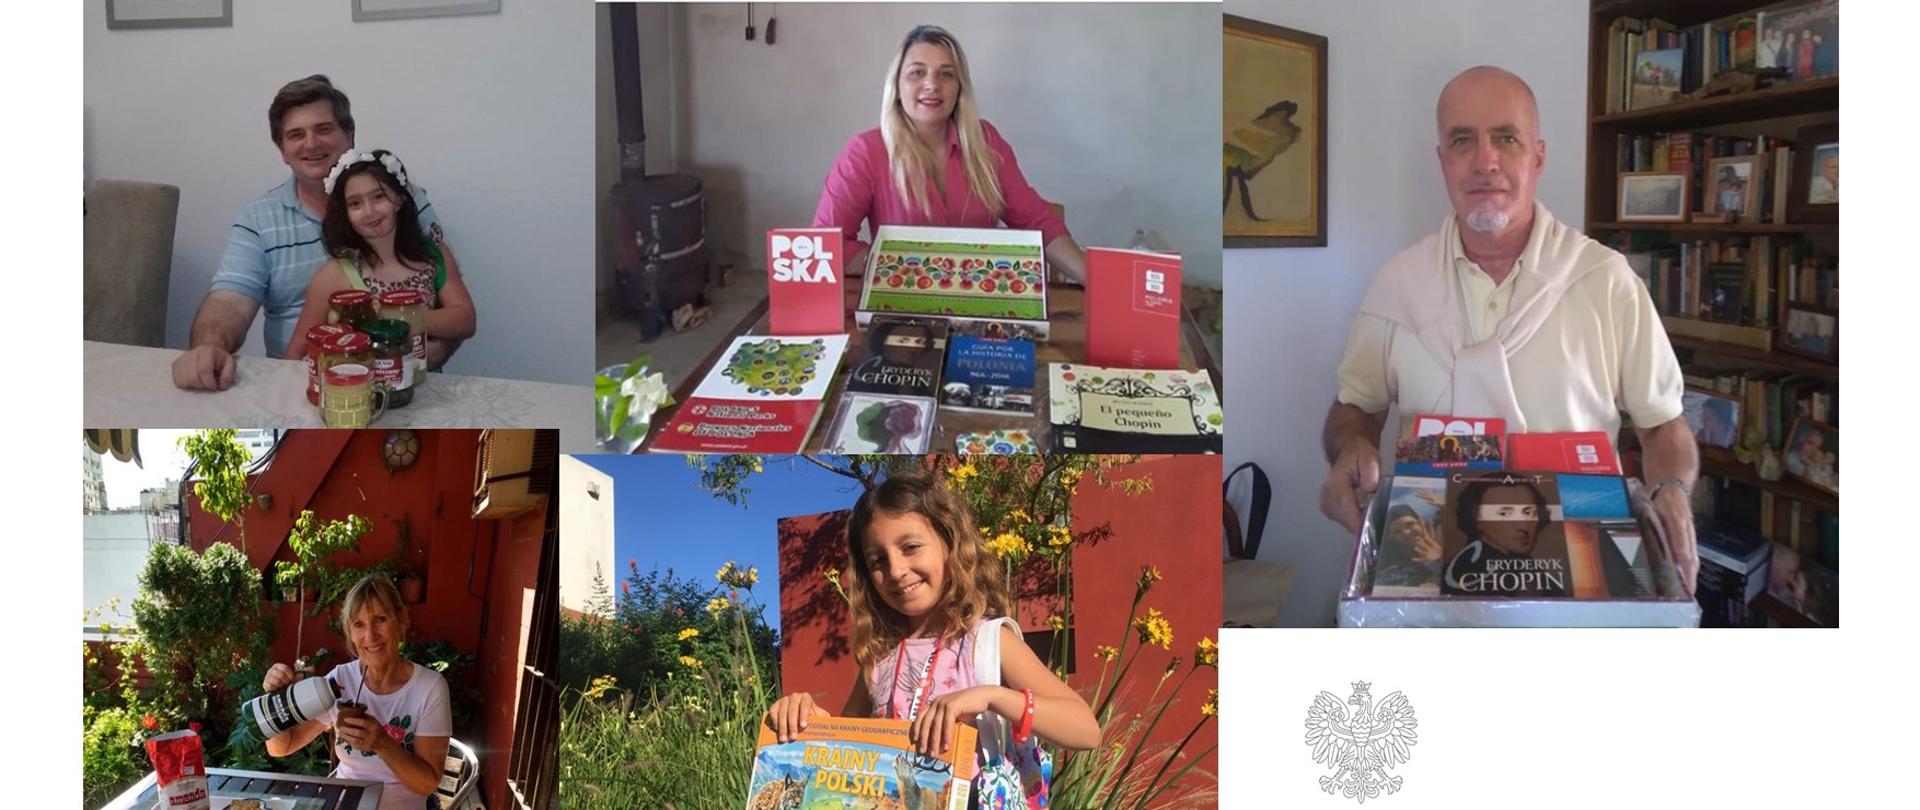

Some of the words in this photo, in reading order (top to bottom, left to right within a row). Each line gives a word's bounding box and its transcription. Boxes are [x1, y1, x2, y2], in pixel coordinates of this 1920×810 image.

[771, 235, 833, 260] POL
[773, 258, 837, 283] SKA
[971, 350, 1013, 359] HISTORIA
[957, 357, 1027, 372] POLONIA
[862, 372, 931, 387] CHOPIN
[1100, 405, 1111, 414] El
[1116, 407, 1172, 418] pequeño
[1114, 417, 1162, 430] Chopin
[1485, 558, 1564, 571] FRYDERYK
[1459, 572, 1565, 592] CHOPIN
[803, 745, 880, 773] KRAINY
[813, 769, 886, 798] POLSKI
[169, 788, 207, 806] amanda
